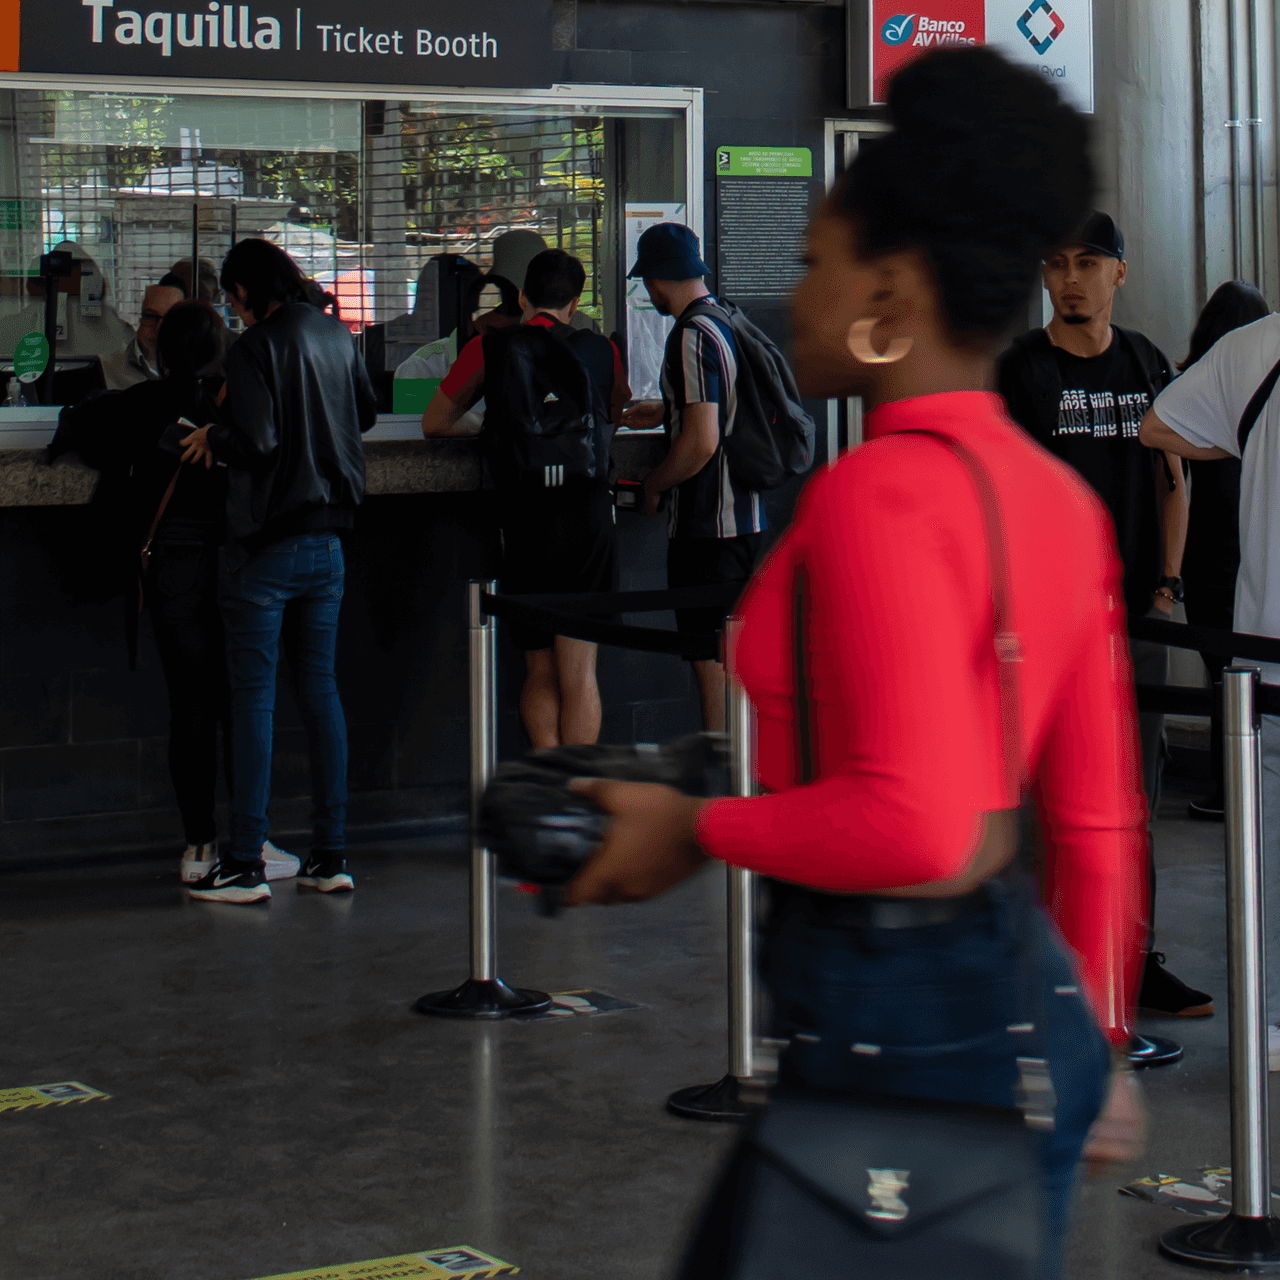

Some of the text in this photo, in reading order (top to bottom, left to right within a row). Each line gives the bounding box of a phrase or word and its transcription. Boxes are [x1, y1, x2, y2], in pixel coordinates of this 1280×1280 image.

[918, 17, 965, 32] Banco
[317, 24, 403, 55] Ticket
[417, 29, 498, 58] Booth
[912, 32, 976, 47] AV Villas
